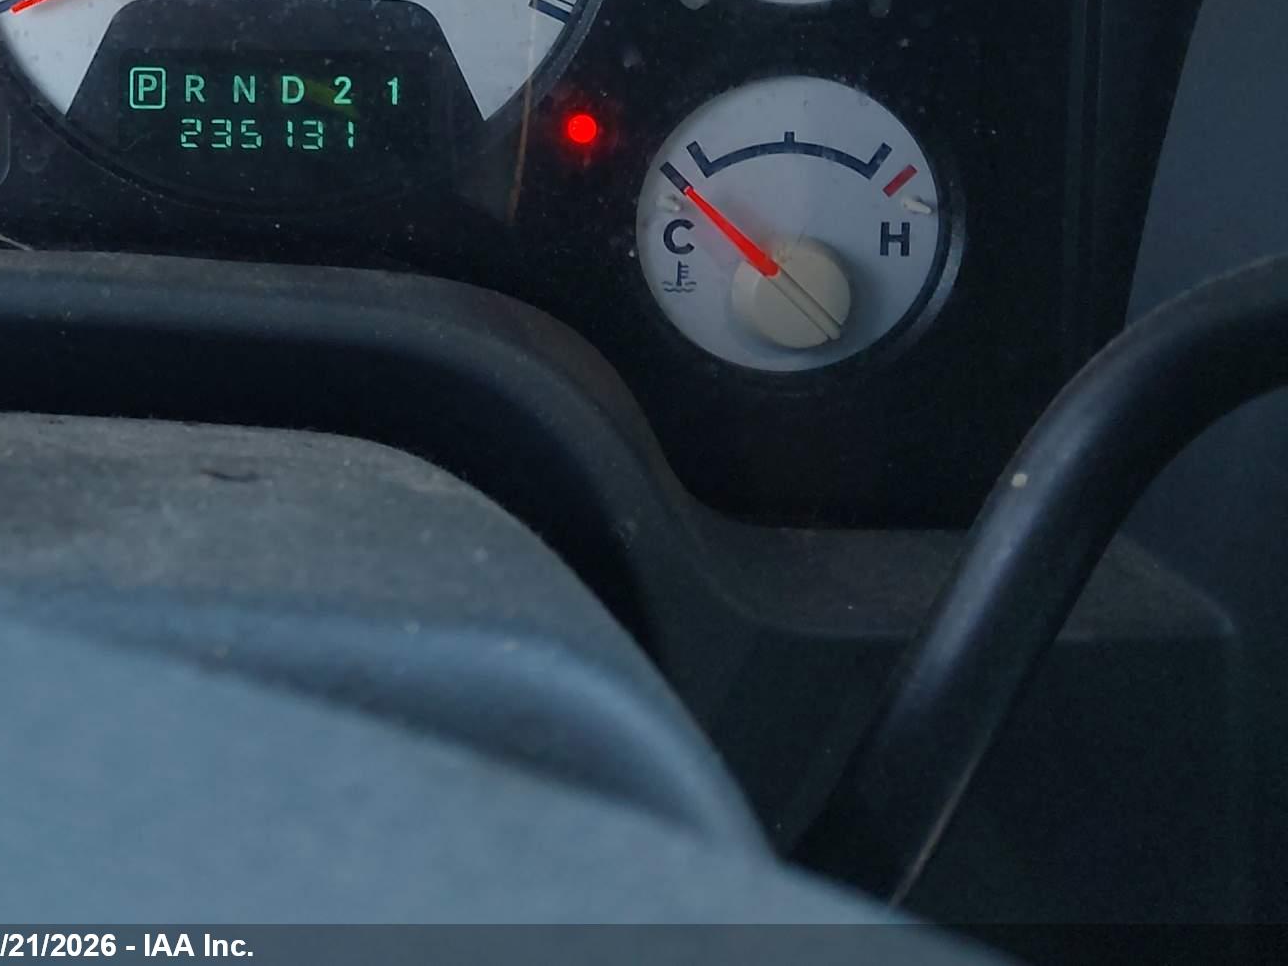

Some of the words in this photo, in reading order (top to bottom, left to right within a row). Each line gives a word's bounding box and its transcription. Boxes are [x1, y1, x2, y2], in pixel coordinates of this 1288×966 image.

[138, 76, 158, 102] P
[185, 75, 206, 103] R
[233, 75, 256, 104] N
[281, 75, 305, 104] D
[333, 76, 353, 105] 2
[387, 77, 399, 105] 1
[180, 118, 355, 150] 235131
[662, 219, 695, 255] C
[880, 221, 910, 257] H
